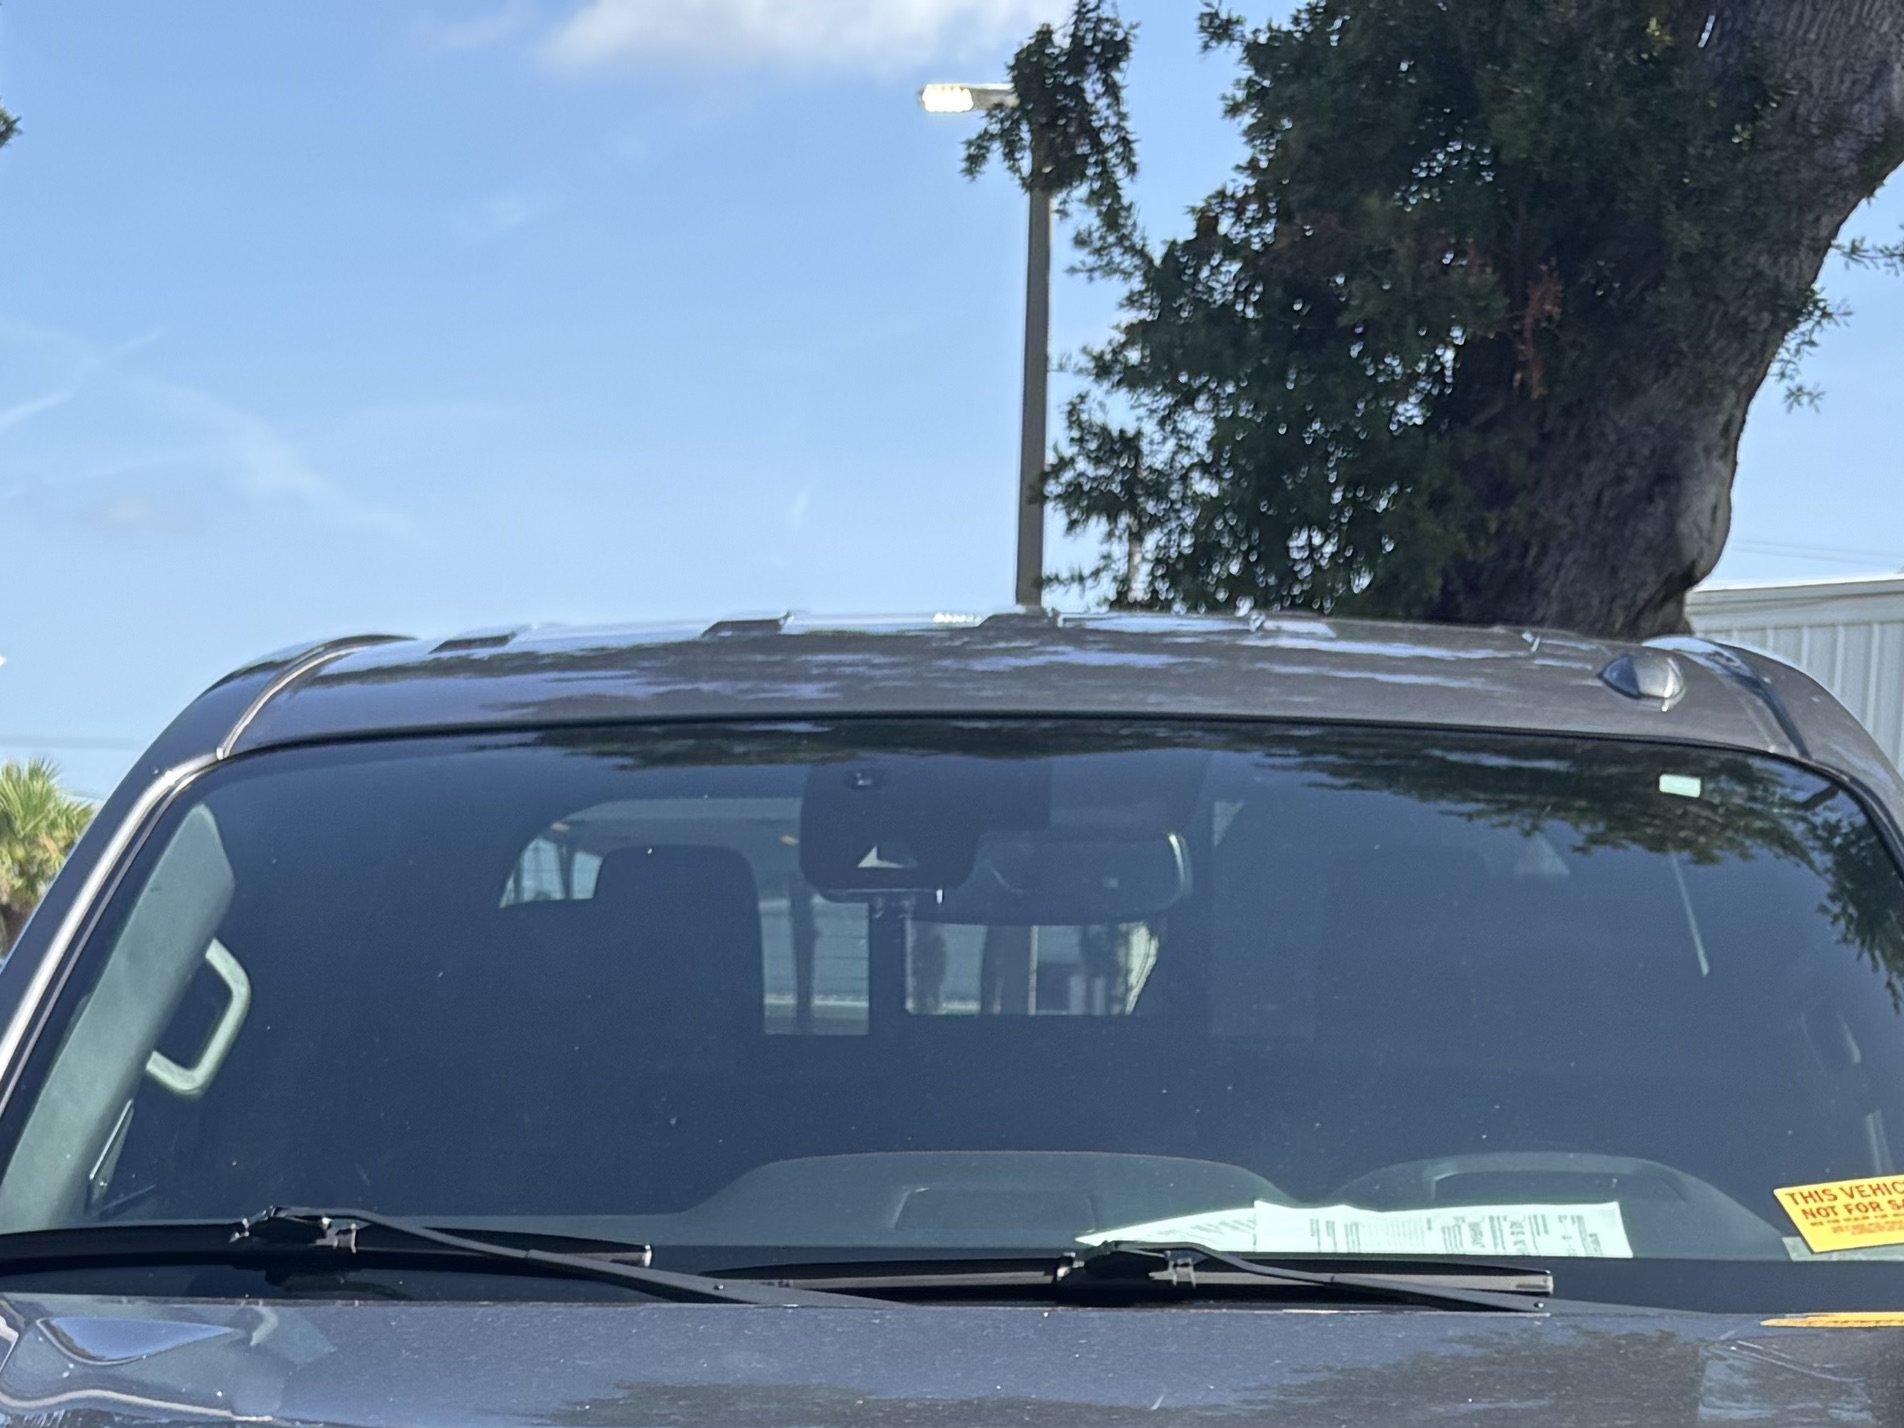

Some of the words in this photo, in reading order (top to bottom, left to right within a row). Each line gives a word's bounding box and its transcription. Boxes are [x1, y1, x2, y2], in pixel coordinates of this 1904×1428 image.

[1785, 1188, 1838, 1206] THIS
[1801, 1205, 1843, 1220] NOT
[1844, 1200, 1883, 1215] FOR
